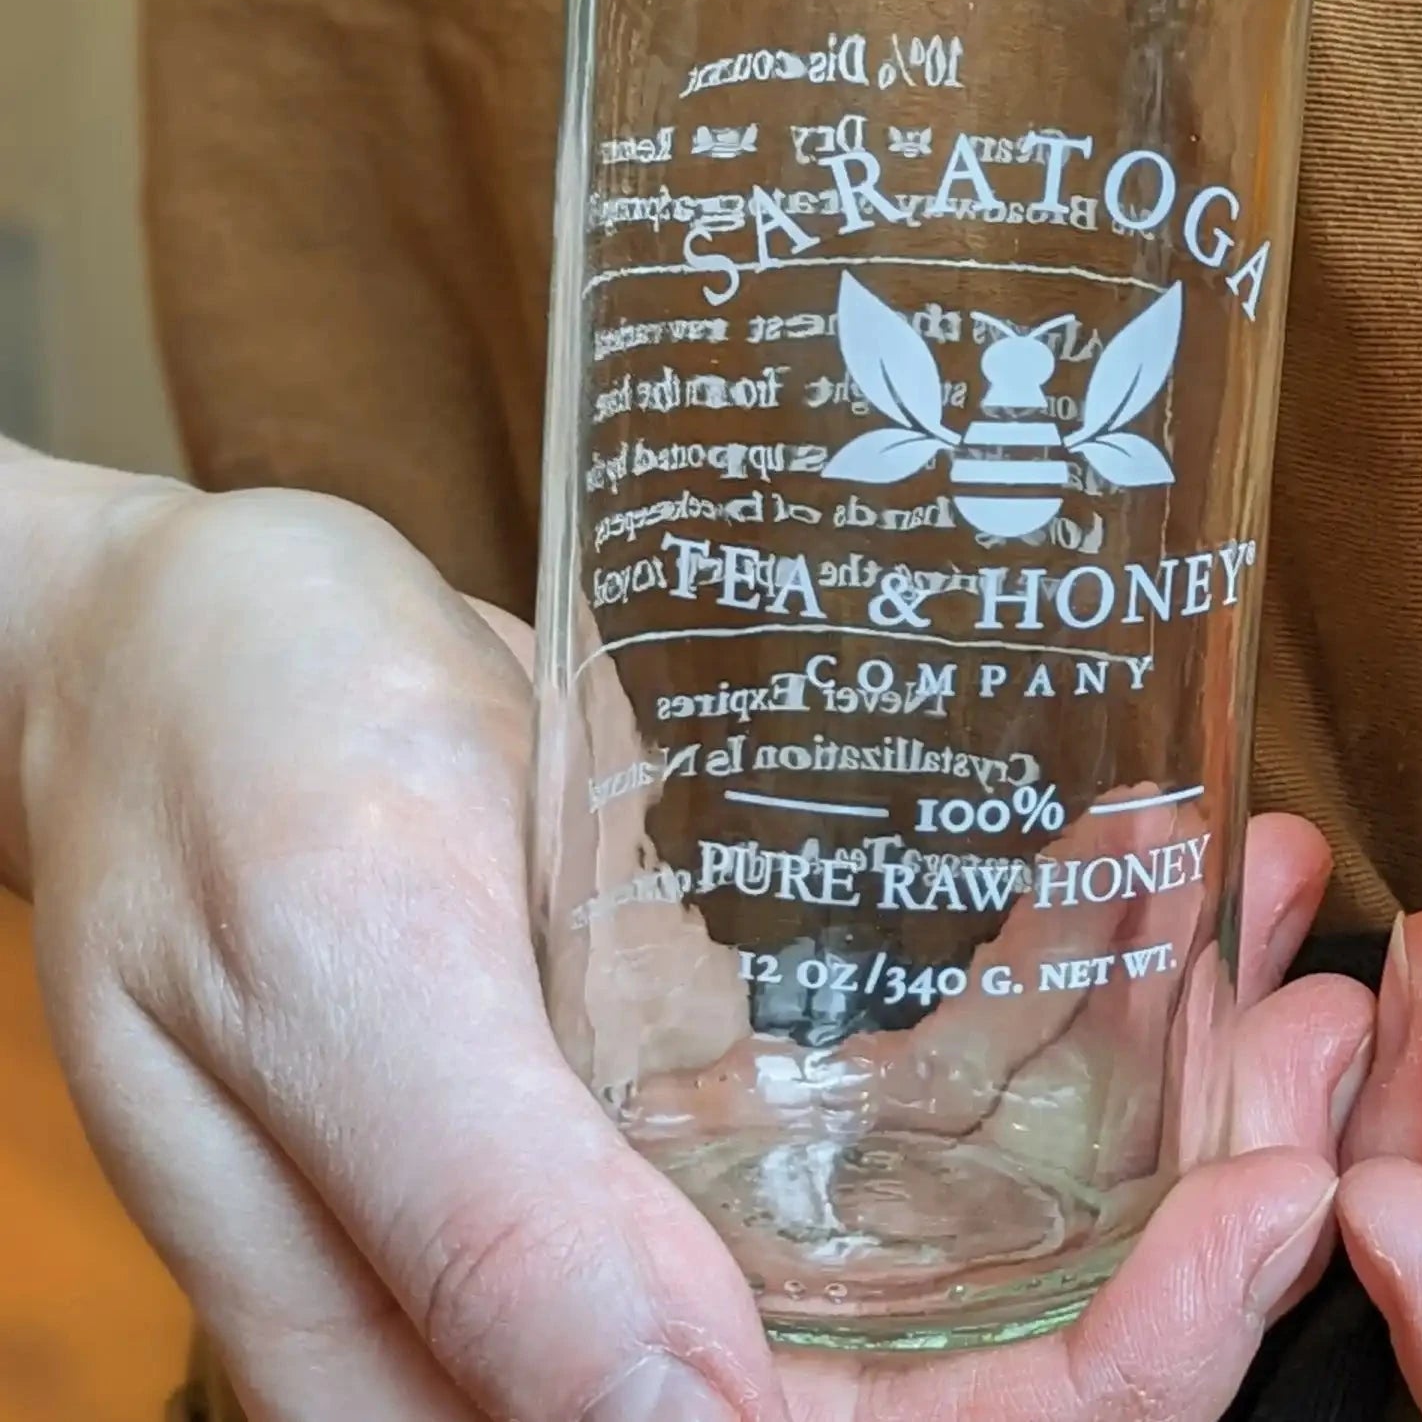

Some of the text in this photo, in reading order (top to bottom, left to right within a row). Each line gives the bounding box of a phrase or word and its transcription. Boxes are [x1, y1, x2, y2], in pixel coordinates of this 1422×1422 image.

[684, 132, 1271, 321] SARATOGA
[661, 532, 827, 620] TEA
[868, 562, 933, 629] &
[805, 655, 1154, 699] COMPANY
[914, 784, 1066, 835] 100%
[700, 839, 861, 908] PURE
[875, 874, 1022, 913] RAW
[1034, 833, 1213, 910] HONEY
[737, 941, 1178, 1005] 12 OZ/340 G. NET WT.
